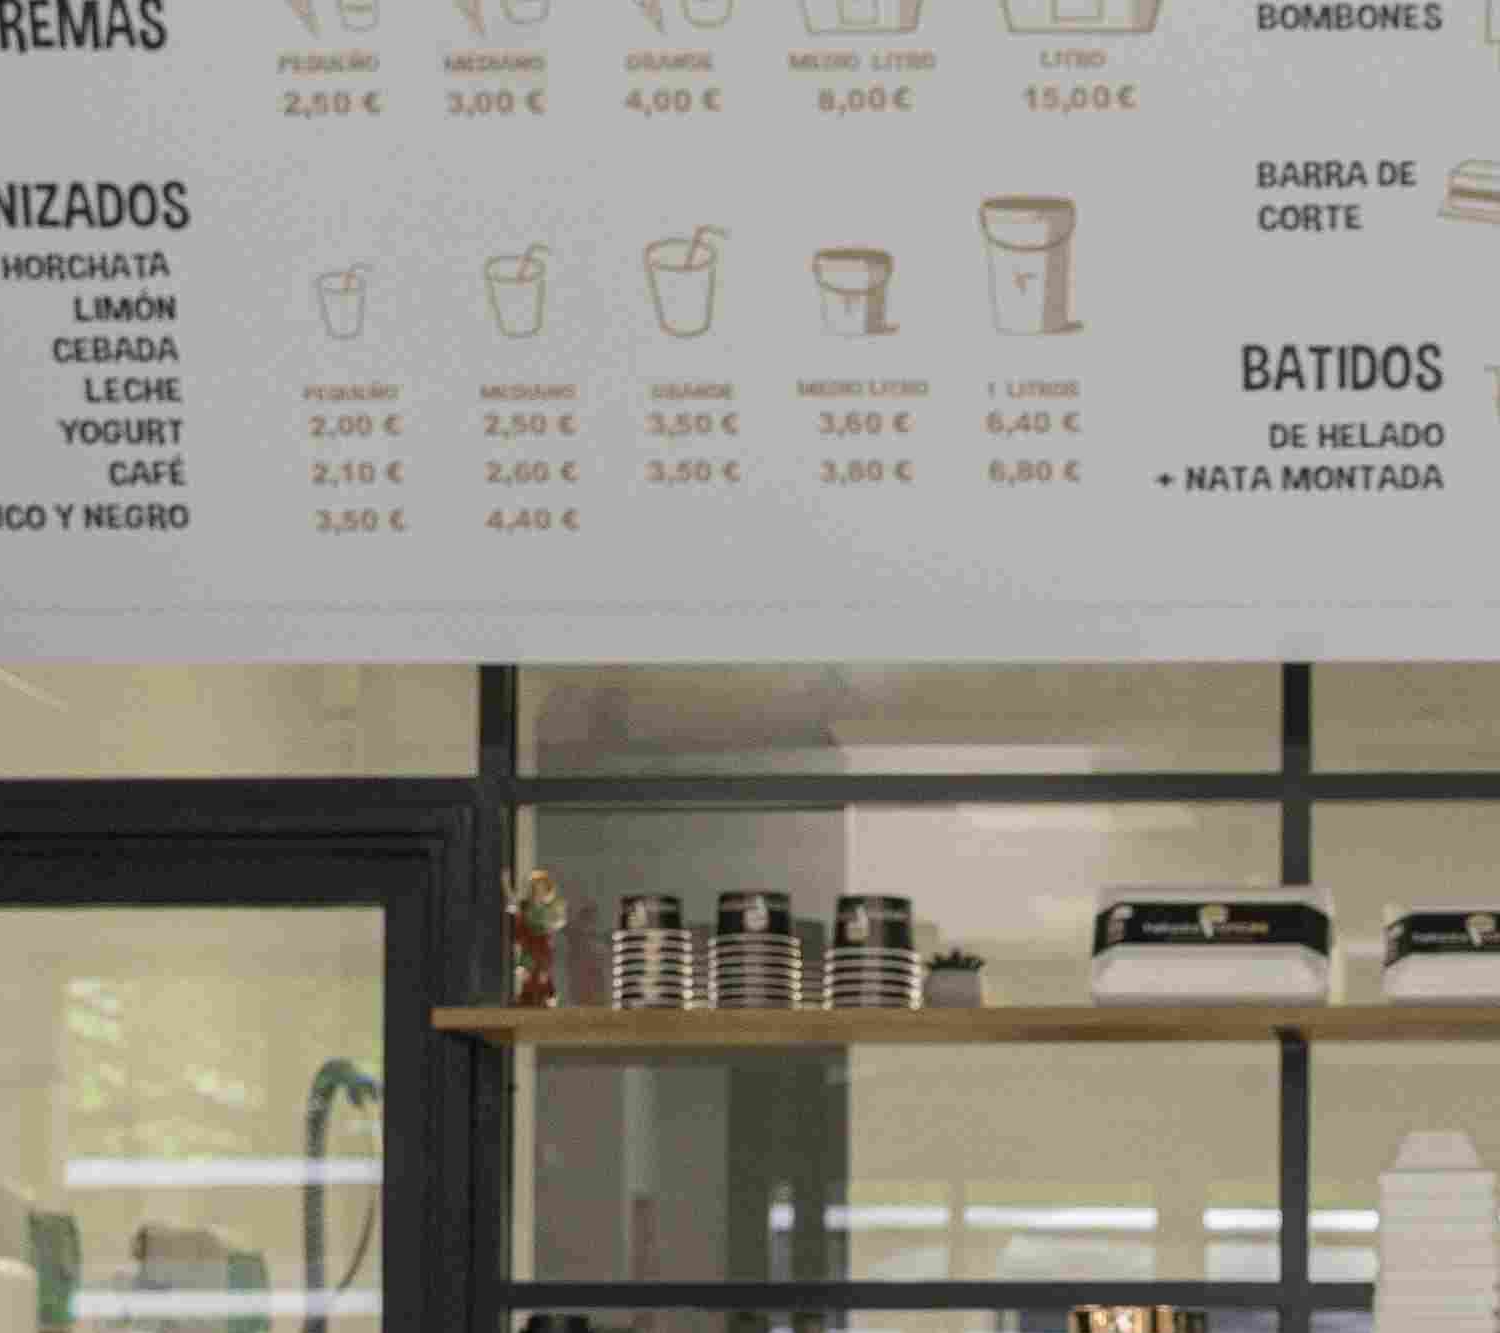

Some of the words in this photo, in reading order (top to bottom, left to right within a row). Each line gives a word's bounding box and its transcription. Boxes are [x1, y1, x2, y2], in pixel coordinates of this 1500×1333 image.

[1257, 2, 1443, 31] BOMBONES
[363, 90, 381, 116] €
[525, 90, 548, 116] €
[701, 89, 723, 113] €
[1257, 160, 1368, 190] BARRA
[1377, 160, 1418, 188] DE
[1257, 203, 1363, 232] CORTE
[1, 252, 170, 281] HORCHATA
[74, 288, 178, 323] LIMÓN
[52, 336, 179, 364] CEBADA
[1241, 342, 1445, 392] BATIDOS
[85, 376, 184, 404] LECHE
[58, 417, 184, 445] YOGURT
[383, 413, 401, 436] €
[558, 413, 579, 436] €
[721, 413, 740, 436] €
[892, 410, 912, 435] €
[1062, 410, 1081, 435] €
[1269, 423, 1307, 449] DE
[1318, 422, 1445, 449] HELADO
[108, 452, 188, 487] CAFÉ
[386, 461, 404, 485] €
[560, 461, 580, 485] €
[722, 461, 741, 485] €
[895, 459, 914, 484] €
[1064, 459, 1081, 484] €
[1155, 471, 1175, 488] +
[1184, 464, 1272, 493] NATA
[1281, 464, 1445, 492] MONTADA
[54, 503, 75, 530] Y
[85, 503, 190, 531] NEGRO
[388, 508, 405, 533] €
[561, 508, 581, 533] €
